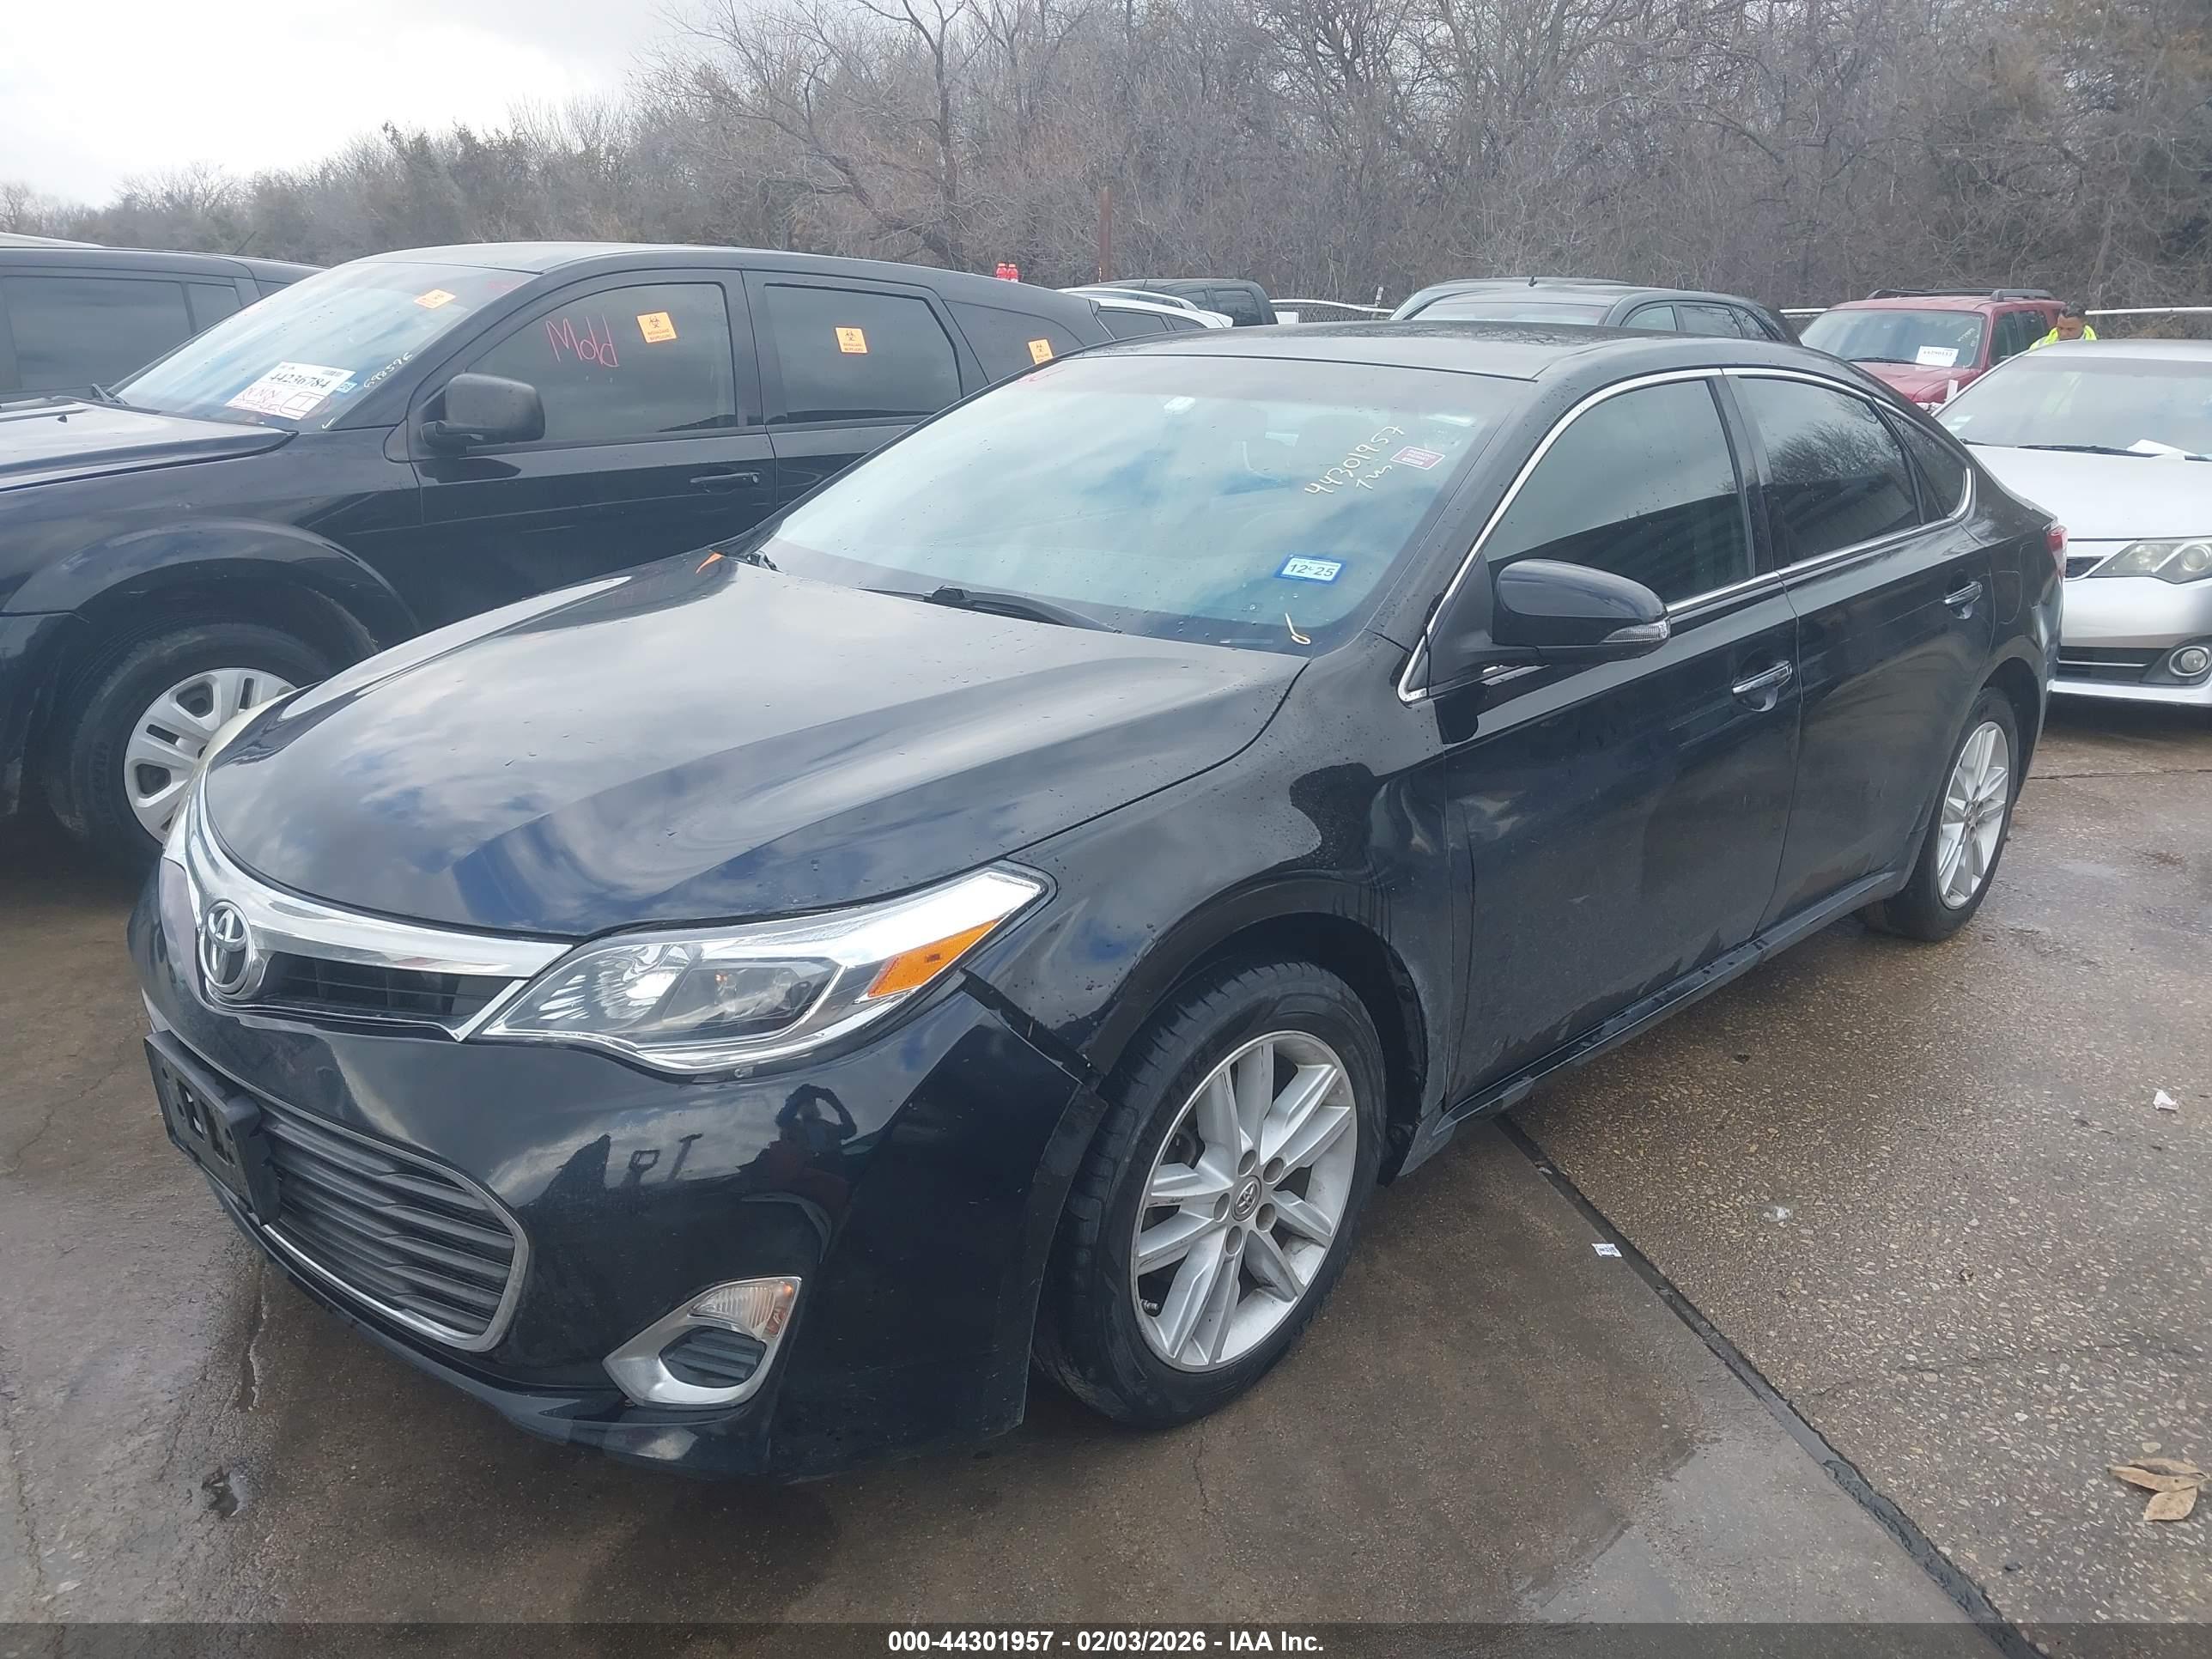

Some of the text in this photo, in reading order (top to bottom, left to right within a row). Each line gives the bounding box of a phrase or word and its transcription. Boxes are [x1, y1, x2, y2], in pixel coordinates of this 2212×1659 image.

[545, 313, 619, 368] Mold
[270, 373, 331, 389] 44236784
[1304, 426, 1405, 494] 44301957
